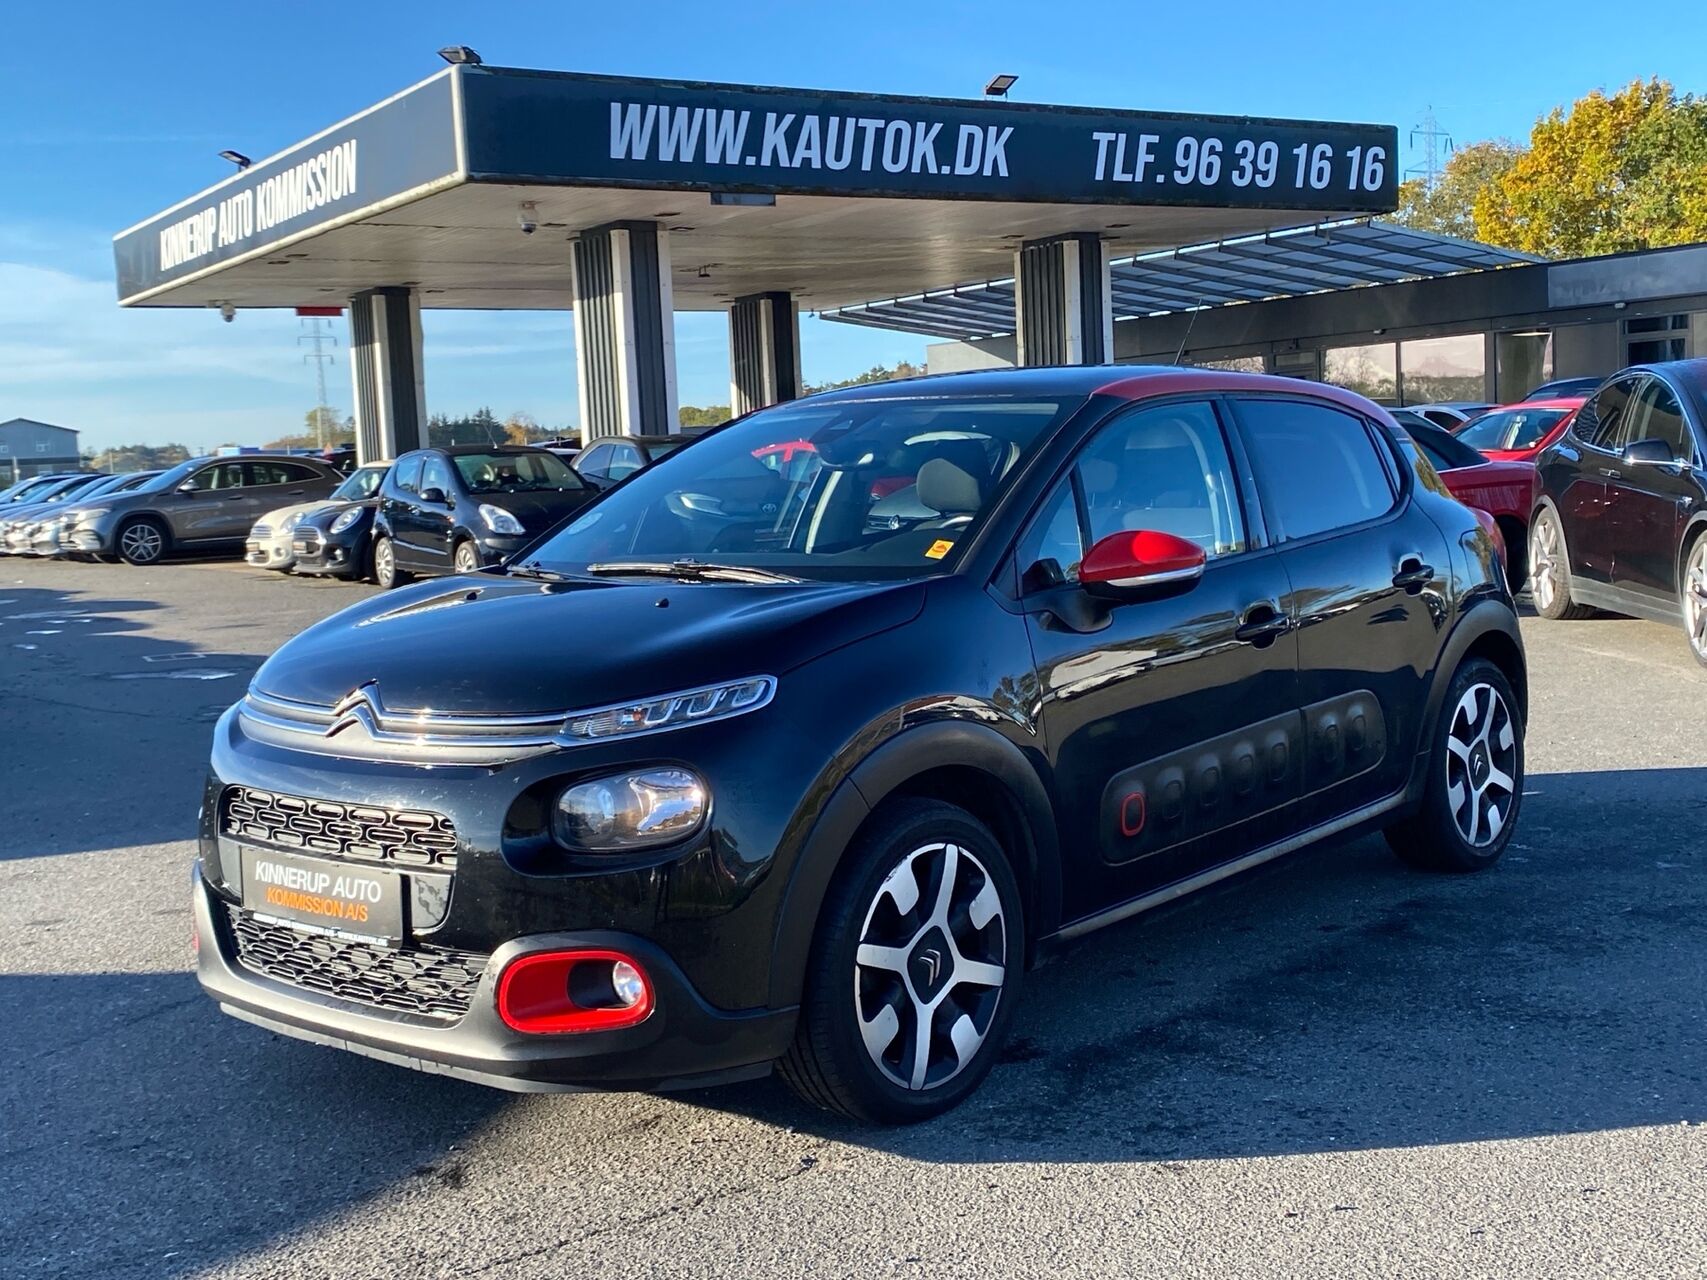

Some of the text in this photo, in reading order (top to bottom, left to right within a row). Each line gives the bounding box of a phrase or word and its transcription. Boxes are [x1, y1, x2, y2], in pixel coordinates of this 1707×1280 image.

[609, 101, 1015, 178] WWW.KAUTOK.DK
[1092, 131, 1386, 192] TLF. 96 39 16 16
[159, 138, 357, 272] KINNERUP AUTO KOMMISSION
[254, 860, 382, 903] KINNERUP AUTO
[266, 887, 368, 922] KOMMISSION A/S
